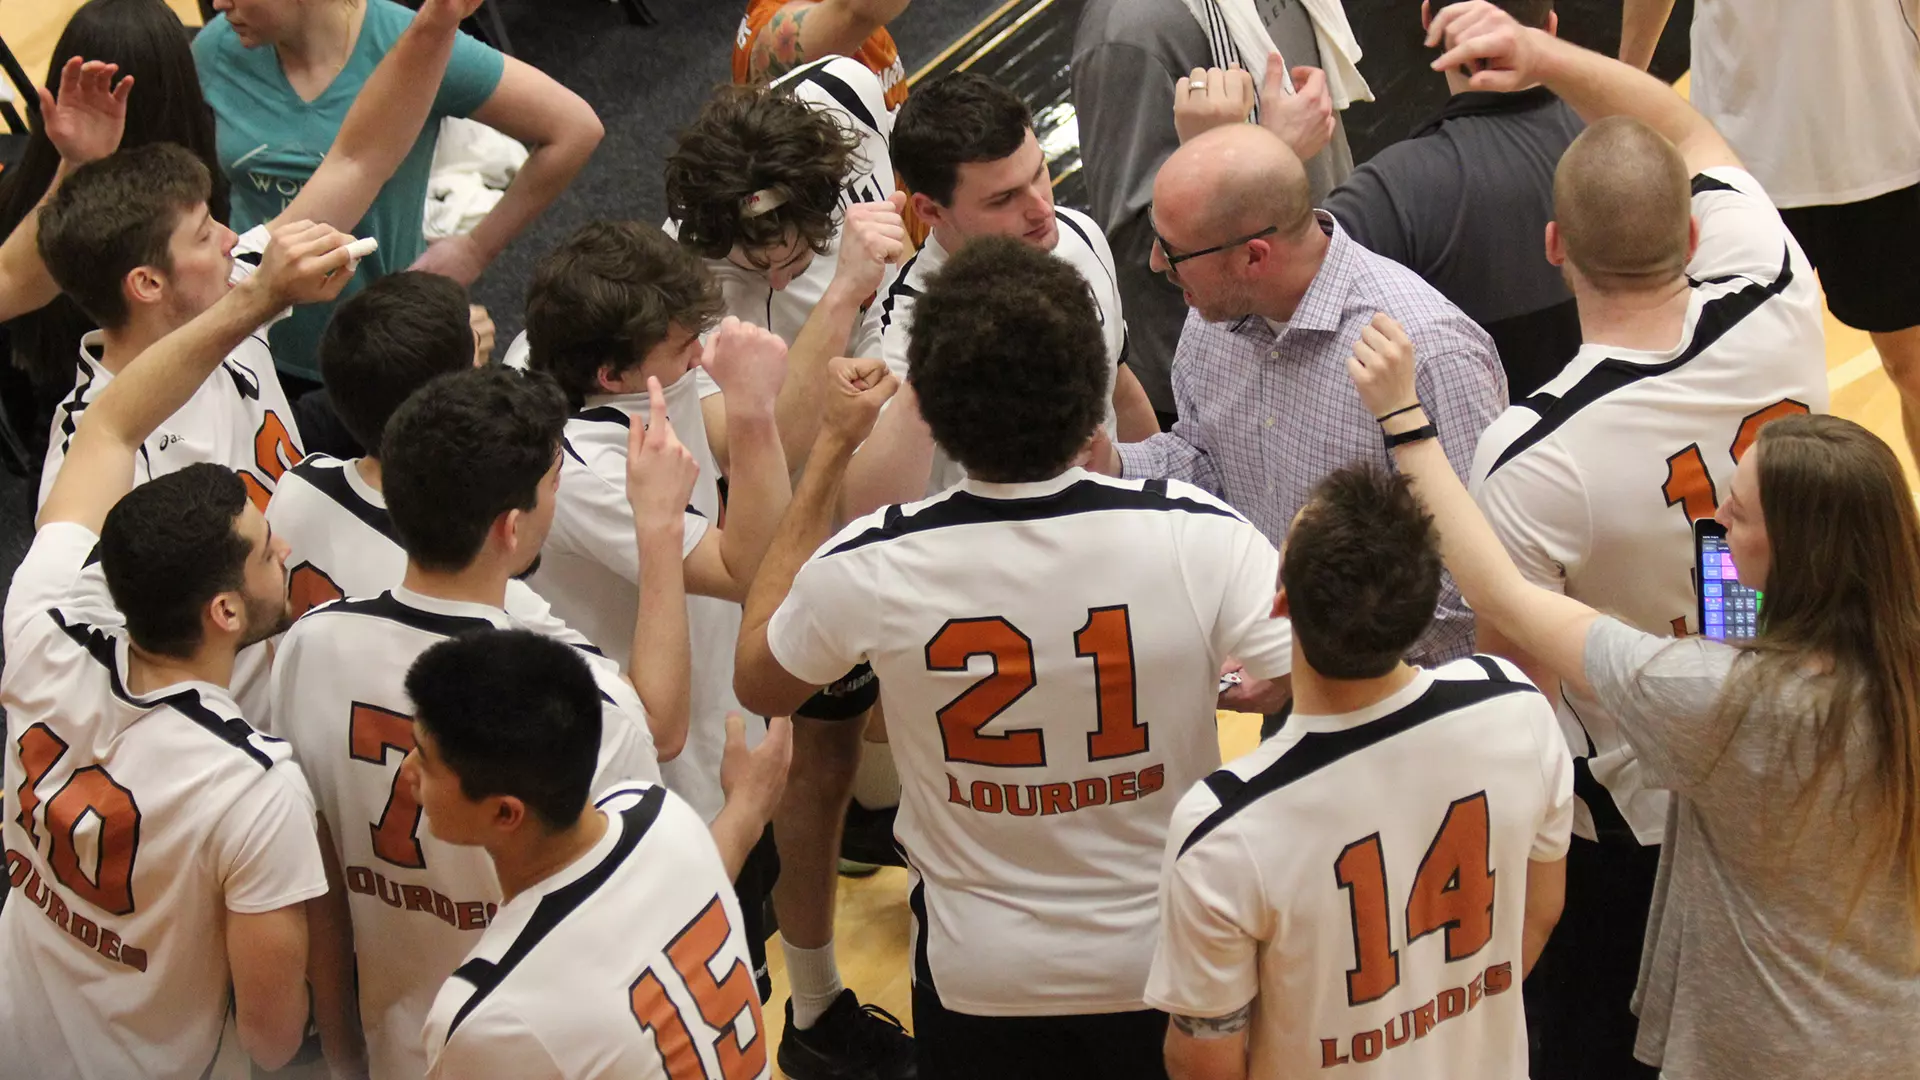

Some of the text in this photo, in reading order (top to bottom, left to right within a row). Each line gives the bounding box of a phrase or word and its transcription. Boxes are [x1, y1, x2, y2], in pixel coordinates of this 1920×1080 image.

[924, 604, 1150, 767] 21
[16, 721, 142, 916] 10
[350, 701, 424, 869] 7
[945, 763, 1165, 816] LOURDES
[5, 848, 148, 973] OURDE
[346, 865, 499, 931] OURDE
[1334, 789, 1496, 1007] 14
[628, 892, 767, 1080] 15
[1320, 960, 1513, 1069] LOURDES
